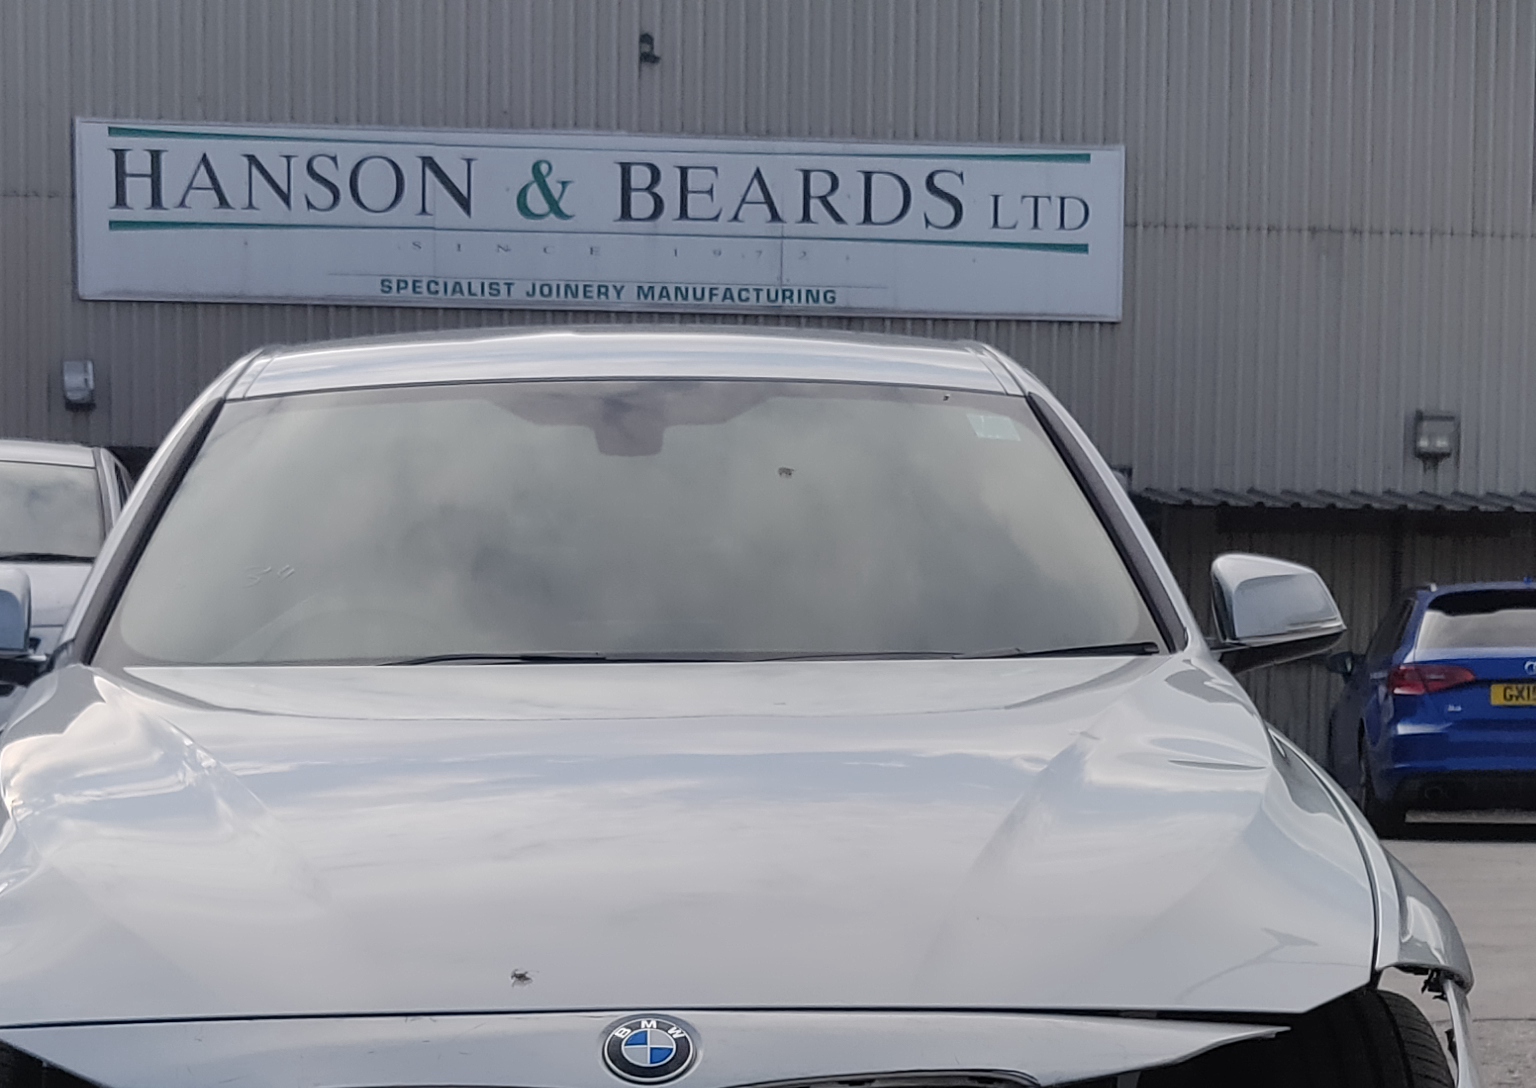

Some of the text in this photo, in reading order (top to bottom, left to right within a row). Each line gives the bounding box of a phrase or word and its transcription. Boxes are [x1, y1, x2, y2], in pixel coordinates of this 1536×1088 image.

[108, 148, 1091, 231] HANSON & BEARDS LTD
[380, 278, 837, 305] SPECIALIST JOINERY MANUFACTURING
[614, 1019, 686, 1039] BMW
